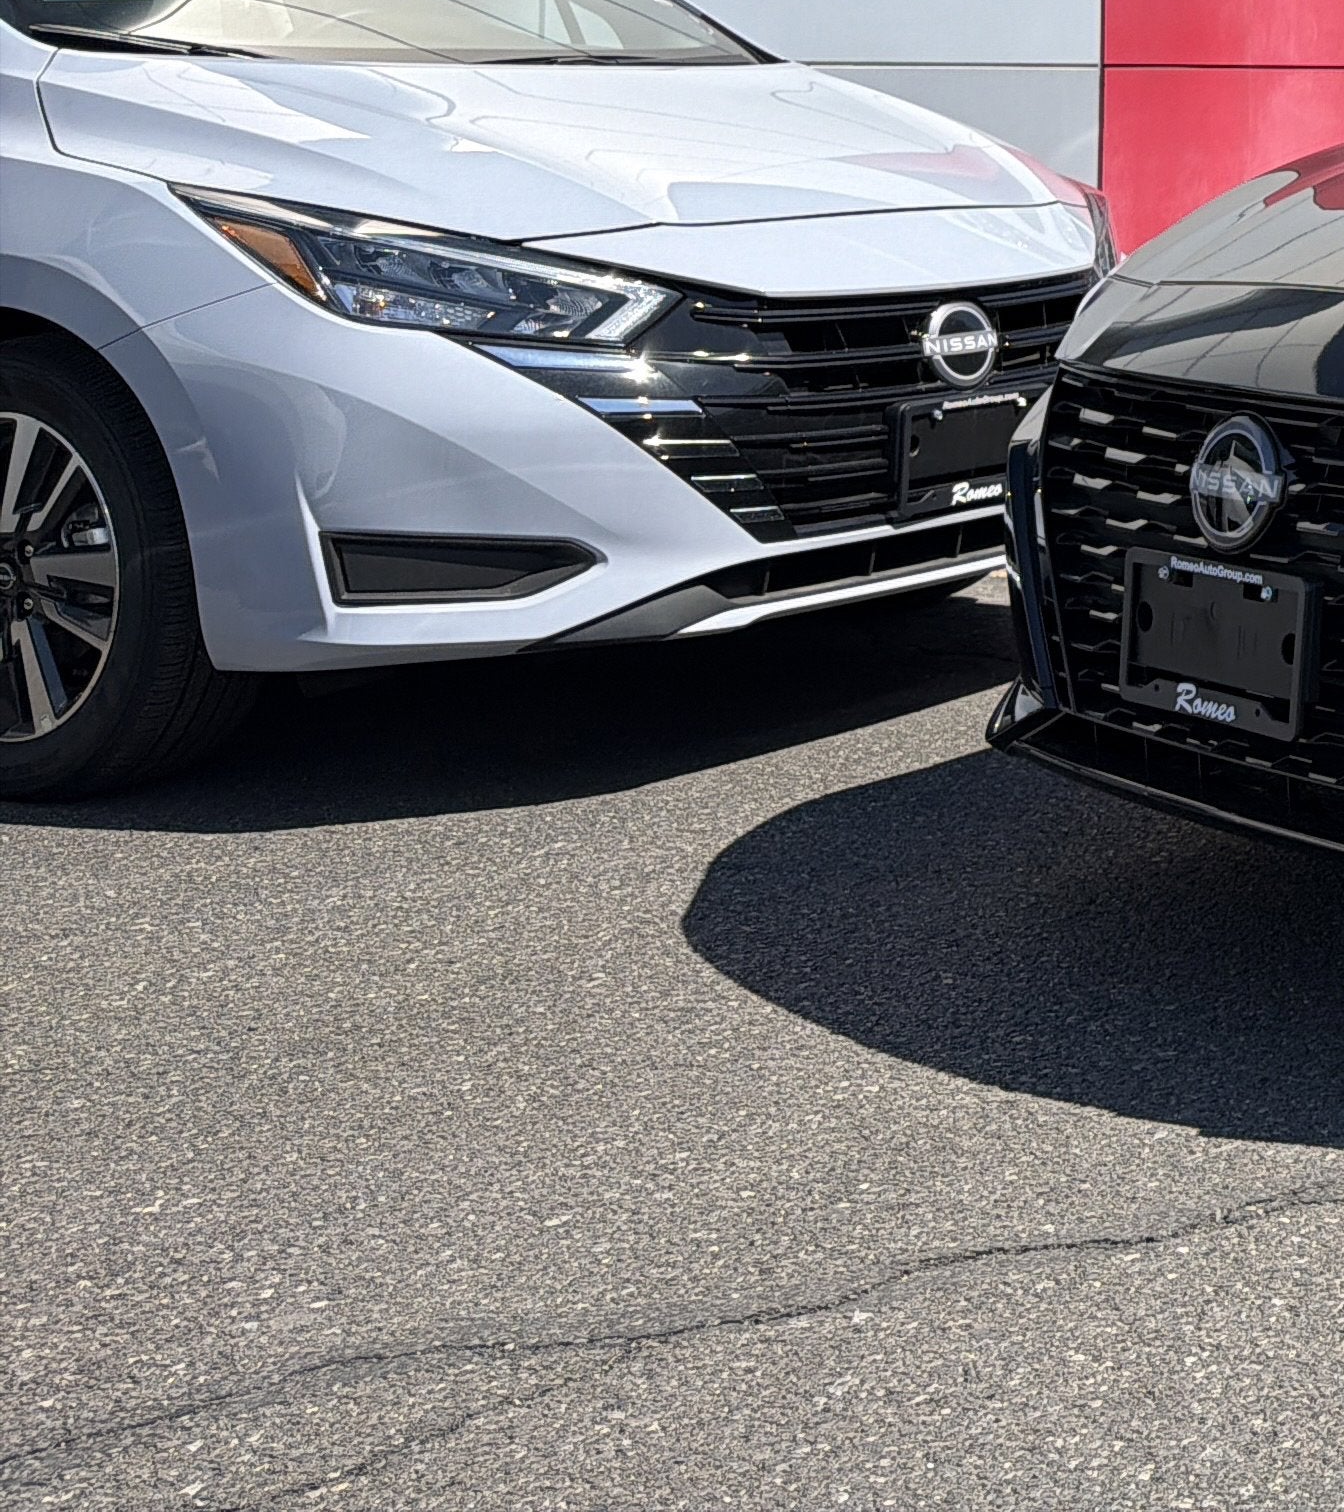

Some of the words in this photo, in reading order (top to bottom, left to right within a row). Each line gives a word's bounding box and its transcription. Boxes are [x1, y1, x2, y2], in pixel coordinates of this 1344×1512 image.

[925, 333, 998, 354] NISSAN
[951, 481, 1003, 506] Romeo
[1170, 555, 1263, 585] RomeoAutoGroup.com
[1174, 682, 1236, 723] Romeo
